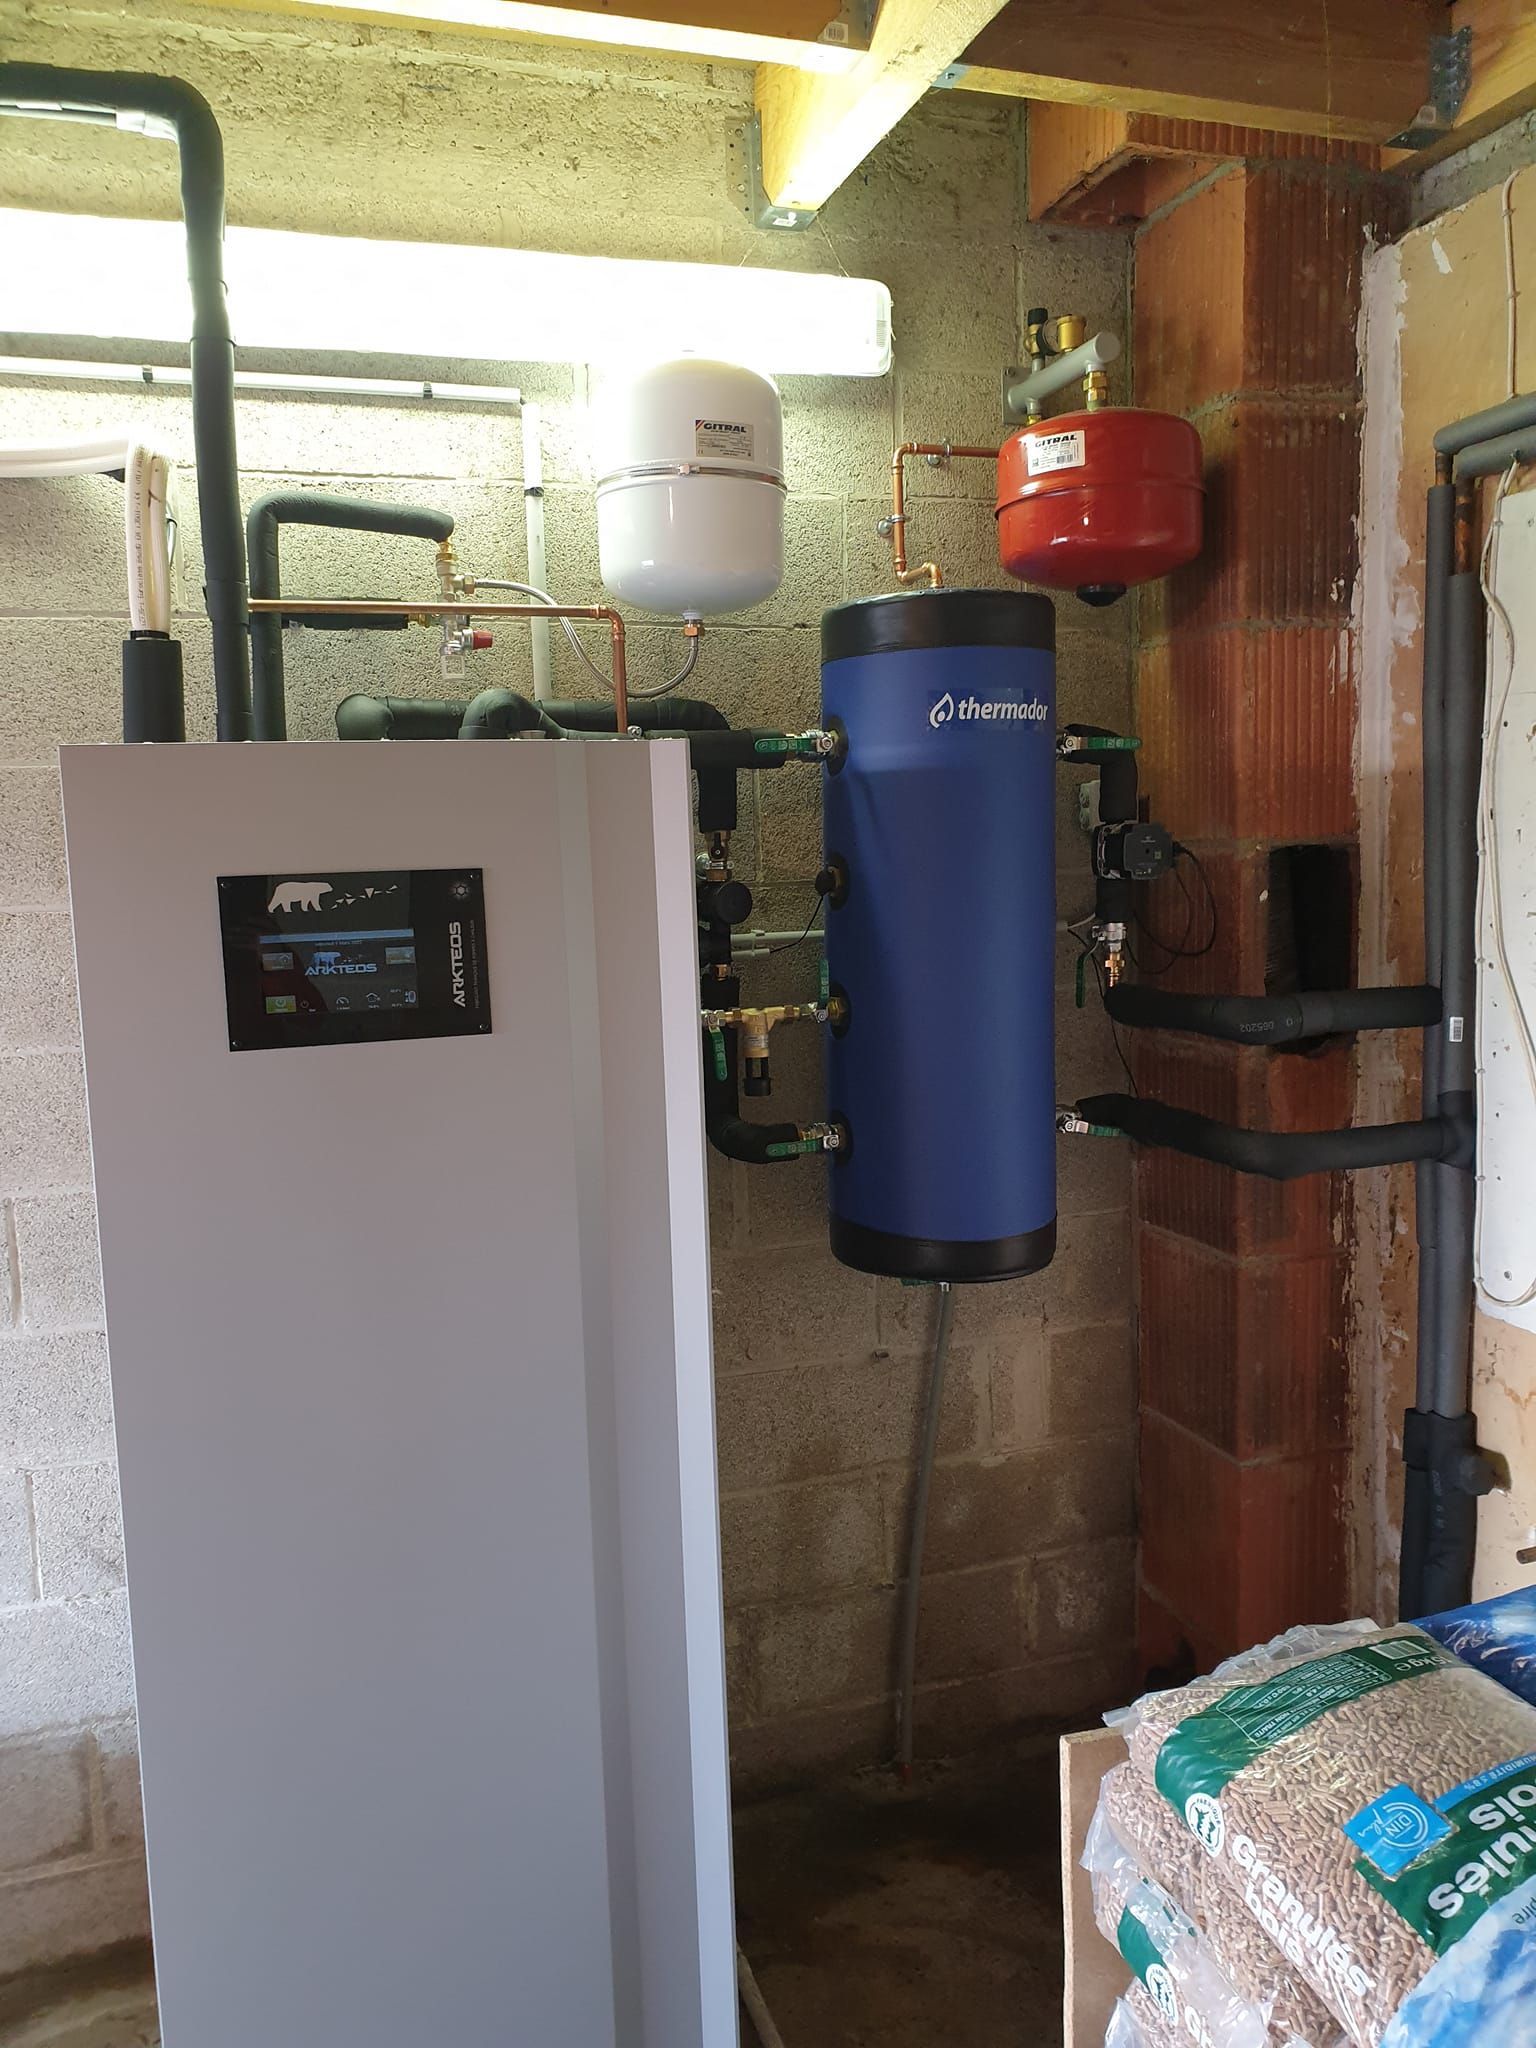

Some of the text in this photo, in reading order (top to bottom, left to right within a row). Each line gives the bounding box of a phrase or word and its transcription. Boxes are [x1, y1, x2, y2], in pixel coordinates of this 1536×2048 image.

[703, 422, 747, 433] GITRAL
[958, 696, 1048, 721] thermador
[304, 962, 378, 976] ARKTEOS
[449, 921, 467, 1008] ARKTEOS
[1386, 1813, 1413, 1837] DIN
[1232, 1834, 1377, 1997] Granulés
